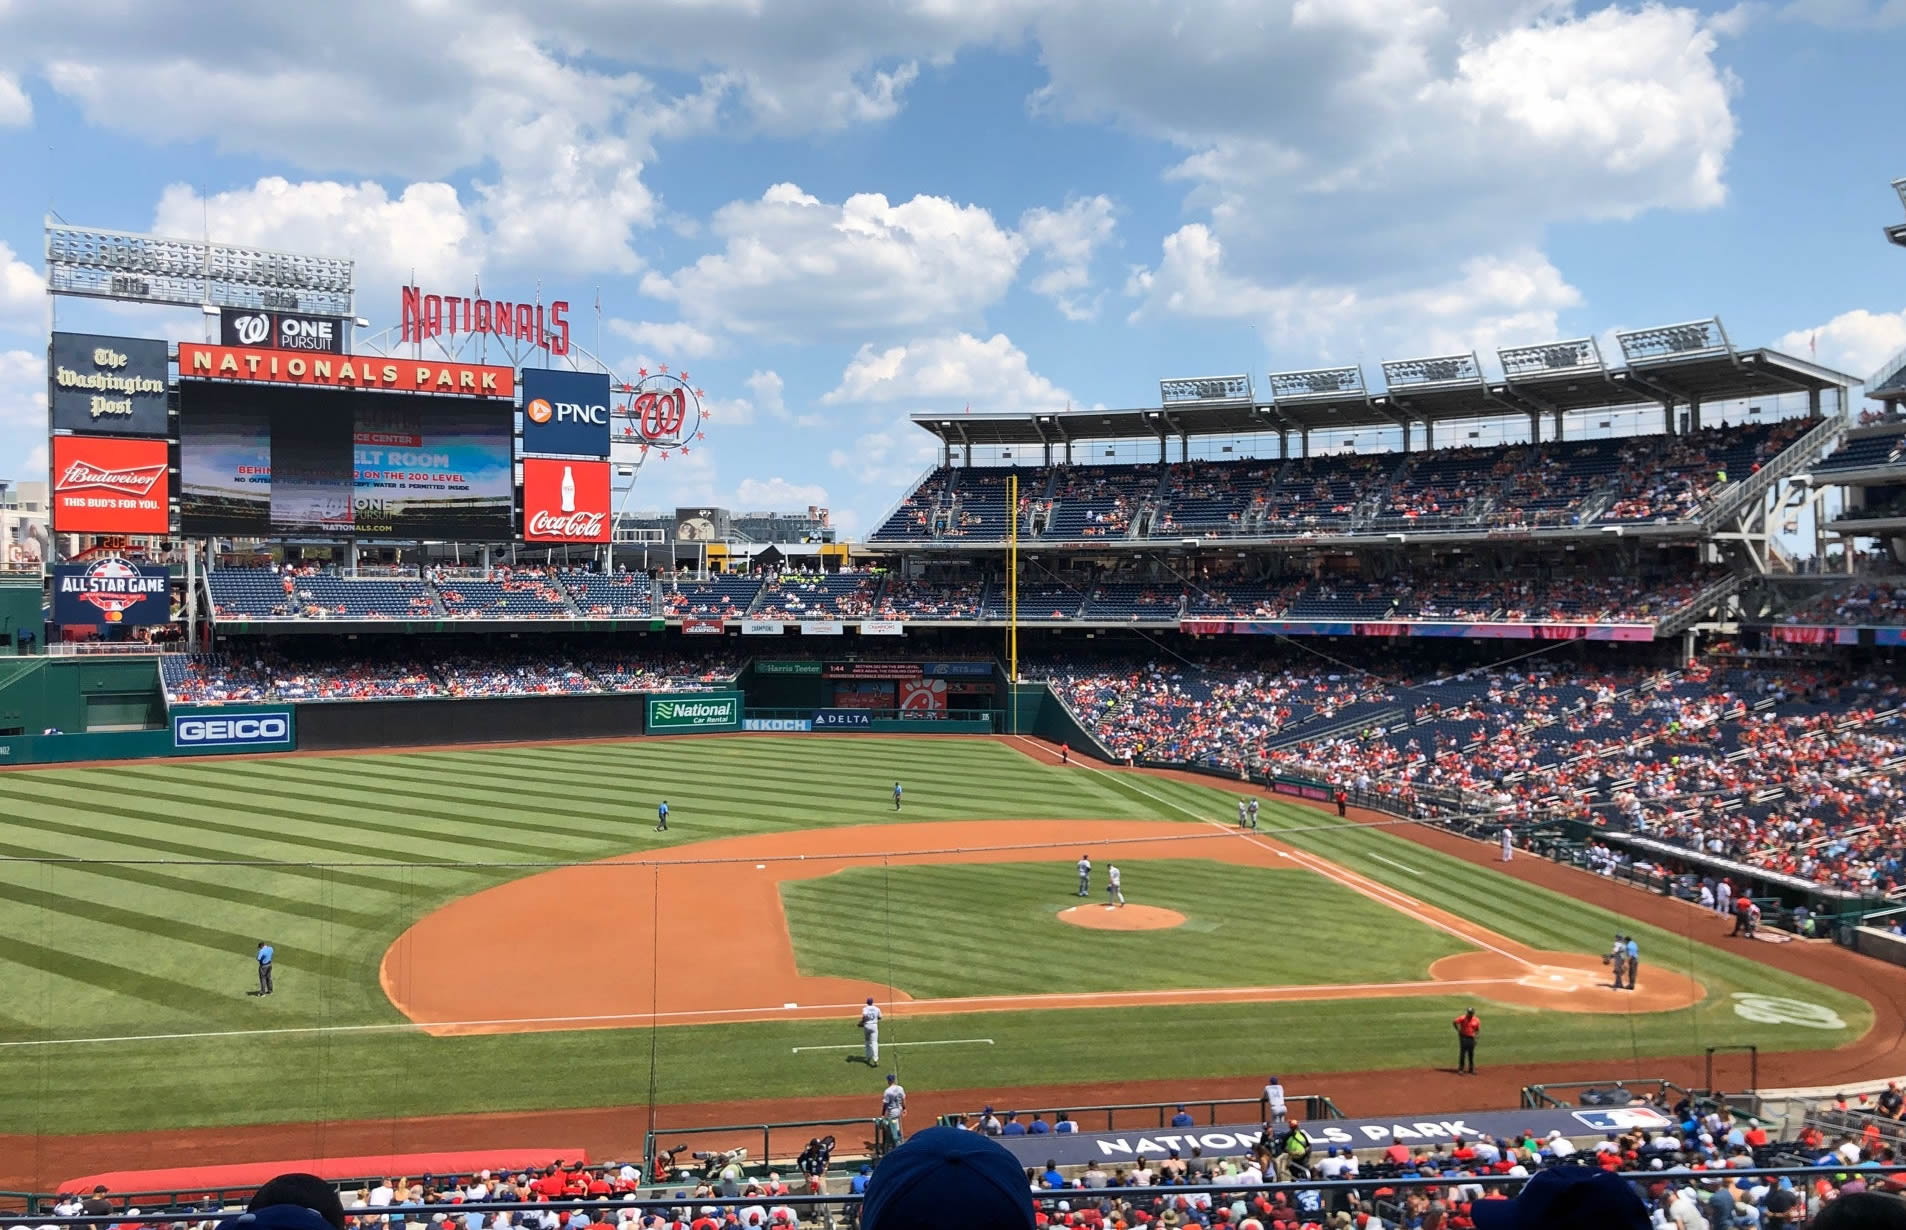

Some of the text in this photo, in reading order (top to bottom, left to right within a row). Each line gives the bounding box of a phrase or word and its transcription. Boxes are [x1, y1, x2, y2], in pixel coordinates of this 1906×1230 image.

[234, 313, 270, 344] W
[282, 319, 333, 338] ONE
[402, 285, 569, 356] NATIONALS
[282, 334, 333, 350] PURSUIT
[94, 348, 128, 369] The
[193, 351, 497, 389] NATIONALS PARK
[57, 366, 164, 395] Washington
[90, 396, 133, 417] Post
[555, 402, 607, 425] PNC
[634, 388, 686, 439] W
[372, 434, 412, 444] CENTER
[388, 452, 449, 468] ROOM
[64, 467, 155, 484] Budweiser
[238, 465, 271, 474] BEHIN
[364, 471, 380, 479] ON
[384, 472, 405, 480] THE
[408, 473, 429, 481] 200
[432, 474, 465, 482] LEVEL
[64, 497, 160, 510] THIS BUD'S FOR YOU.
[354, 499, 393, 510] ONE
[355, 510, 393, 521] PURSUIT
[322, 524, 393, 532] NATIONALS.COM
[529, 511, 606, 538] Coca-Cola
[128, 579, 165, 592] GAME
[673, 702, 731, 717] National
[761, 719, 805, 731] KOCH
[828, 714, 869, 724] DELTA
[179, 718, 285, 741] GEICO
[1096, 1120, 1480, 1156] NATIONLS PARK
